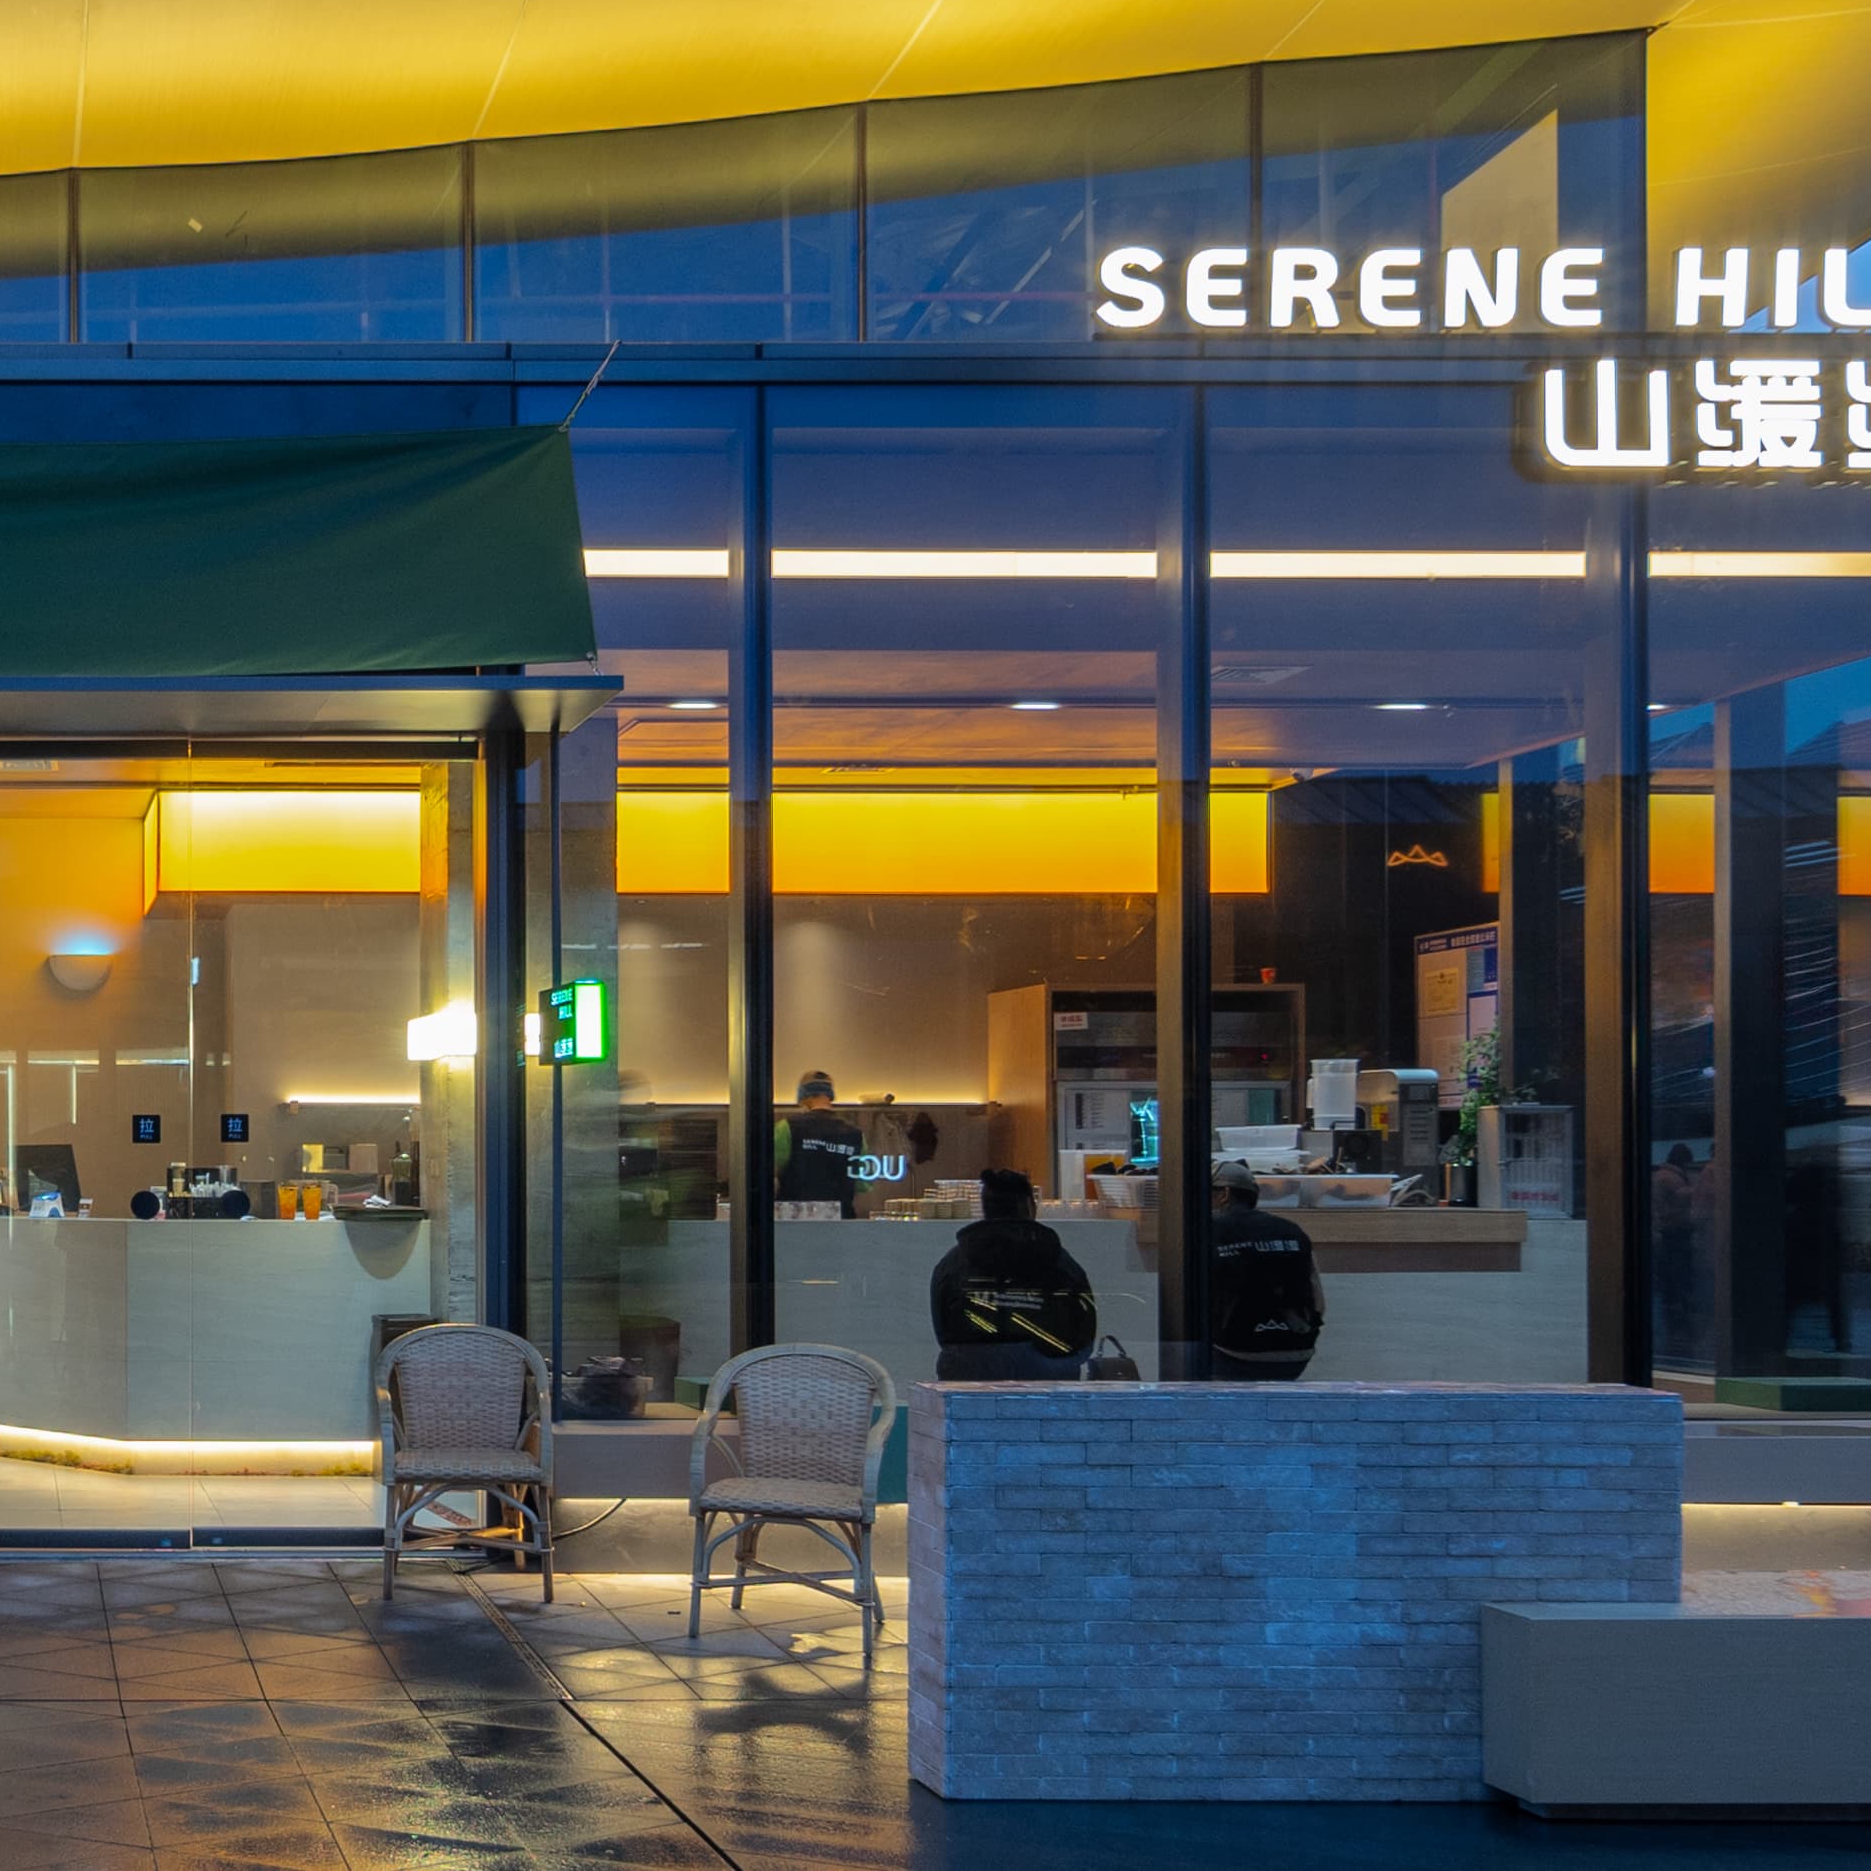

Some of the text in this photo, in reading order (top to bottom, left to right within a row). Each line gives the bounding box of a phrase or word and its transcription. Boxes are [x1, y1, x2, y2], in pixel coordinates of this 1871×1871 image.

[1095, 246, 1605, 328] SERENE
[139, 1118, 155, 1133] 拉
[226, 1117, 242, 1132] 拉
